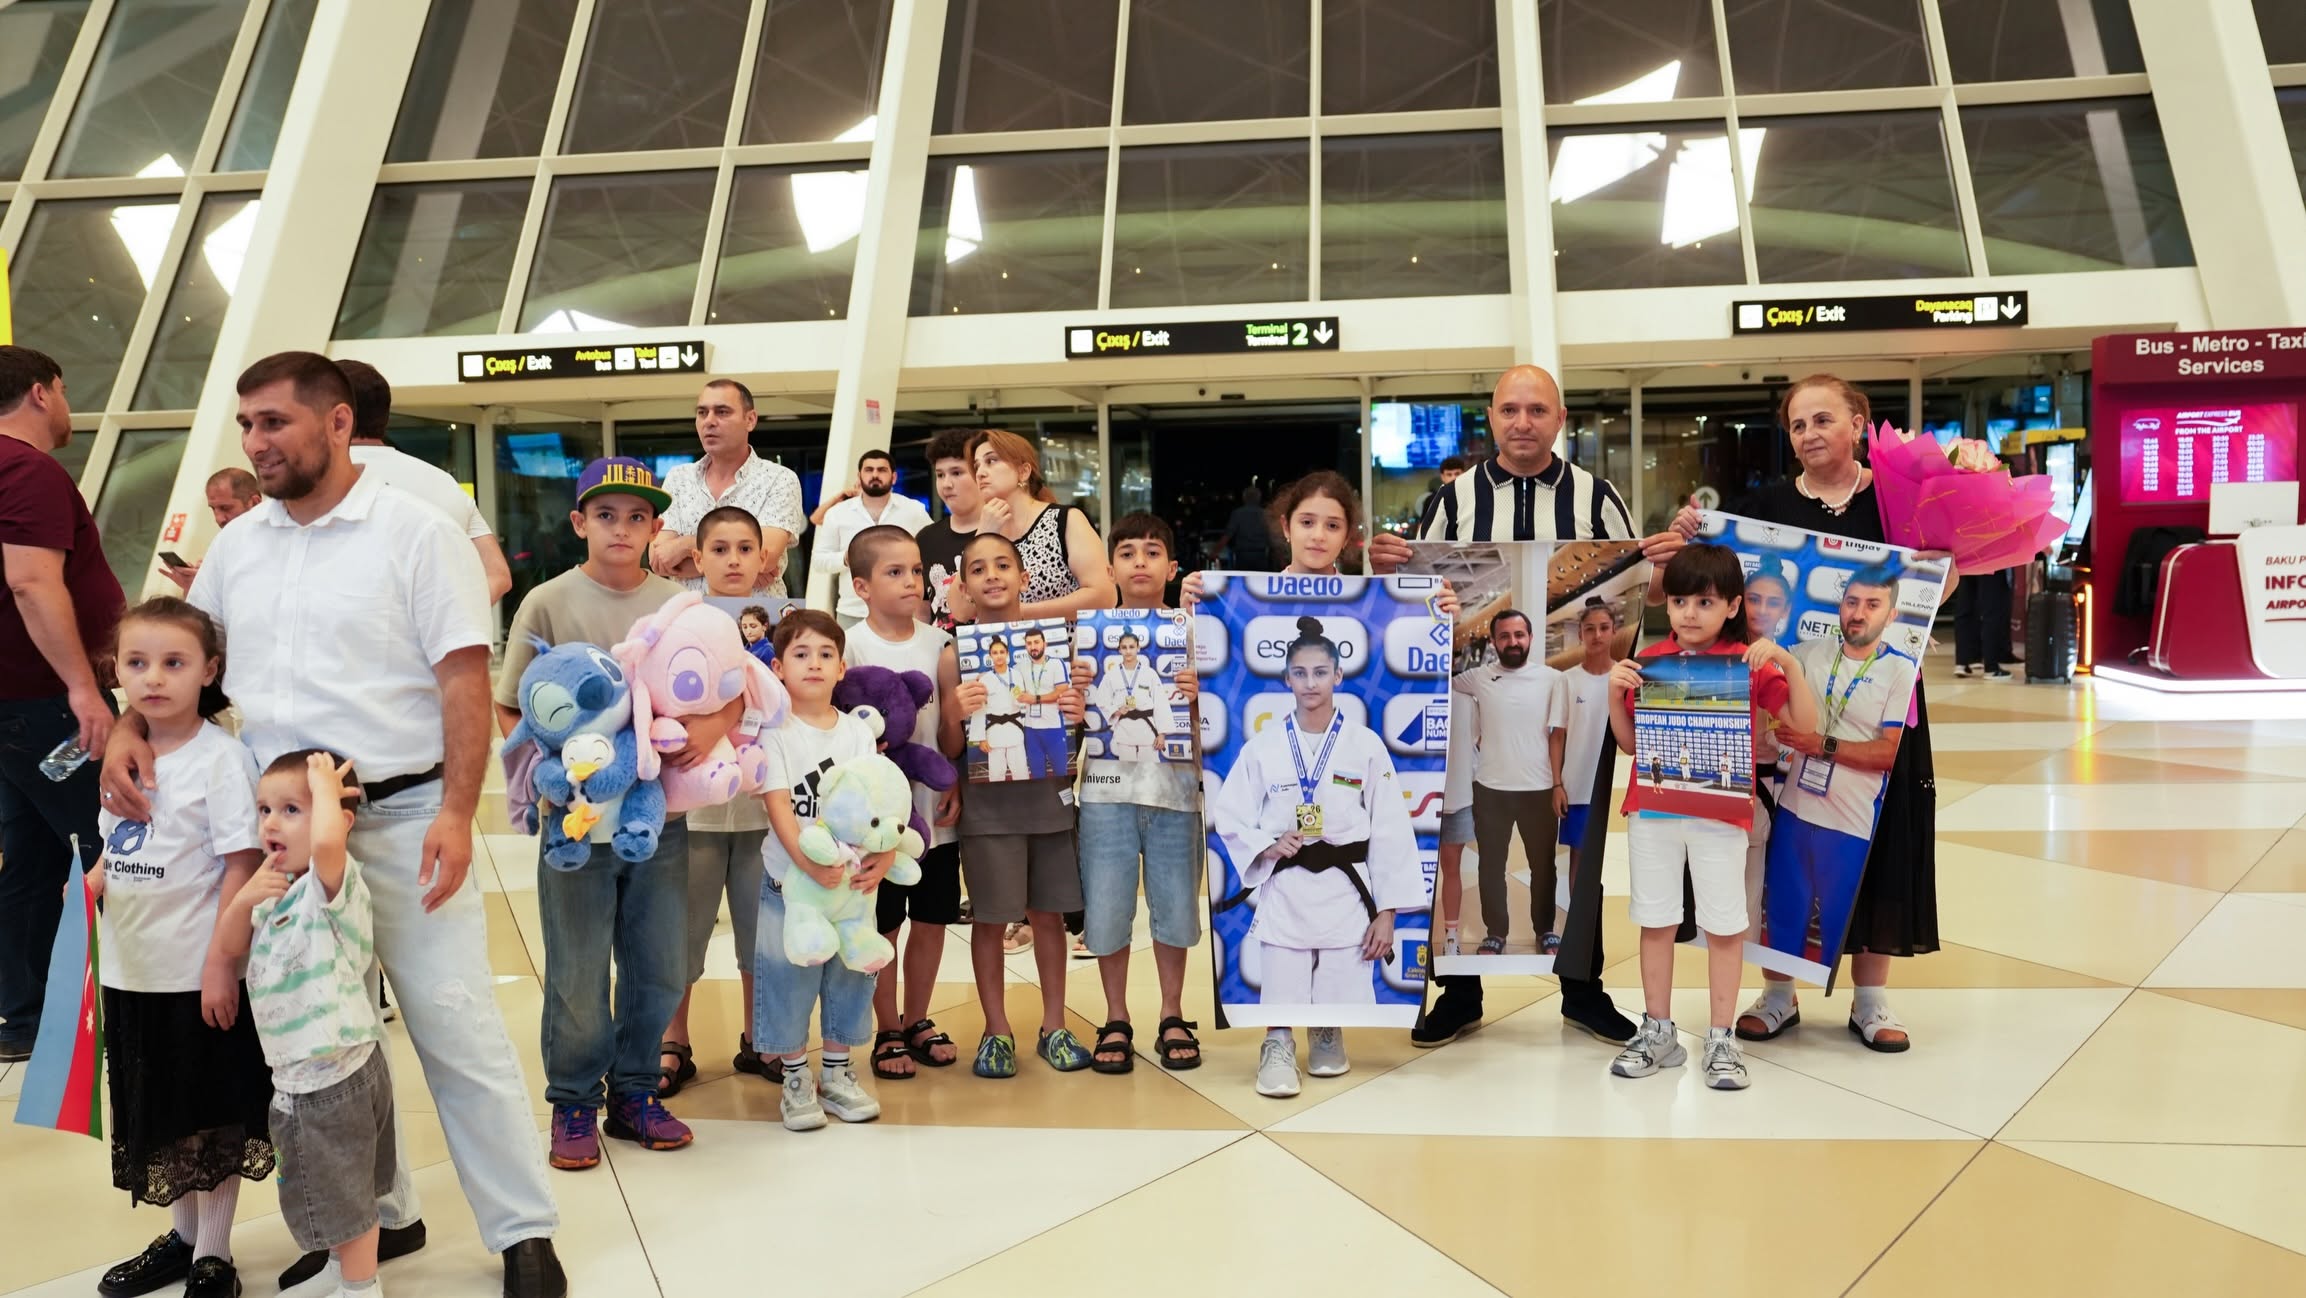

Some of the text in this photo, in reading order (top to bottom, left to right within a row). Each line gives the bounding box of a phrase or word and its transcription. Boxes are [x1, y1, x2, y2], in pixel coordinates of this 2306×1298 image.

[1915, 300, 1973, 313] Dayanacaq
[1816, 305, 1846, 322] Exit
[1933, 311, 1973, 324] Parking
[1246, 323, 1288, 335] Terminal
[1292, 323, 1309, 346] 2
[1142, 330, 1170, 347] Exit
[1246, 334, 1289, 346] Terminal
[2135, 338, 2174, 355] Bus
[2193, 336, 2249, 353] Metro
[2267, 333, 2306, 350] Taxi
[575, 350, 611, 361] Avtobus
[526, 355, 552, 371] Exit
[2178, 357, 2265, 375] Services
[2175, 425, 2243, 435] FROM THE AIRPORT
[2265, 555, 2297, 566] BAKU
[2266, 599, 2306, 610] AIRPO
[1668, 715, 1687, 727] JUDO
[114, 860, 165, 879] Clothing
